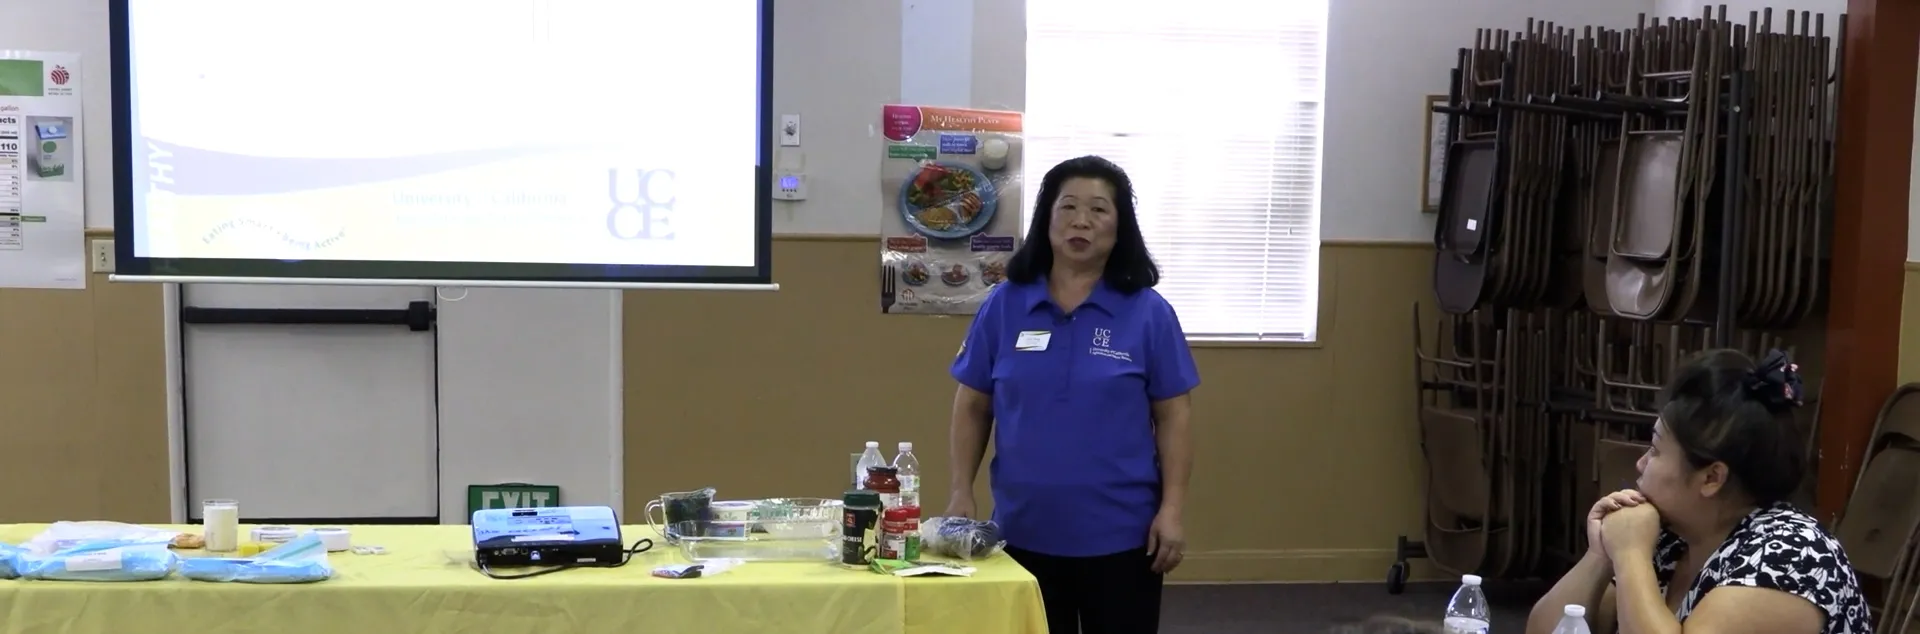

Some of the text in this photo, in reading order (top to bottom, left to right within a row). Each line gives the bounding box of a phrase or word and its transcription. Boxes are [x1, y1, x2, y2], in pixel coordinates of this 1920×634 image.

[1, 143, 18, 151] 110
[201, 218, 236, 245] Eating
[1094, 328, 1111, 338] UC
[1092, 337, 1110, 347] CE
